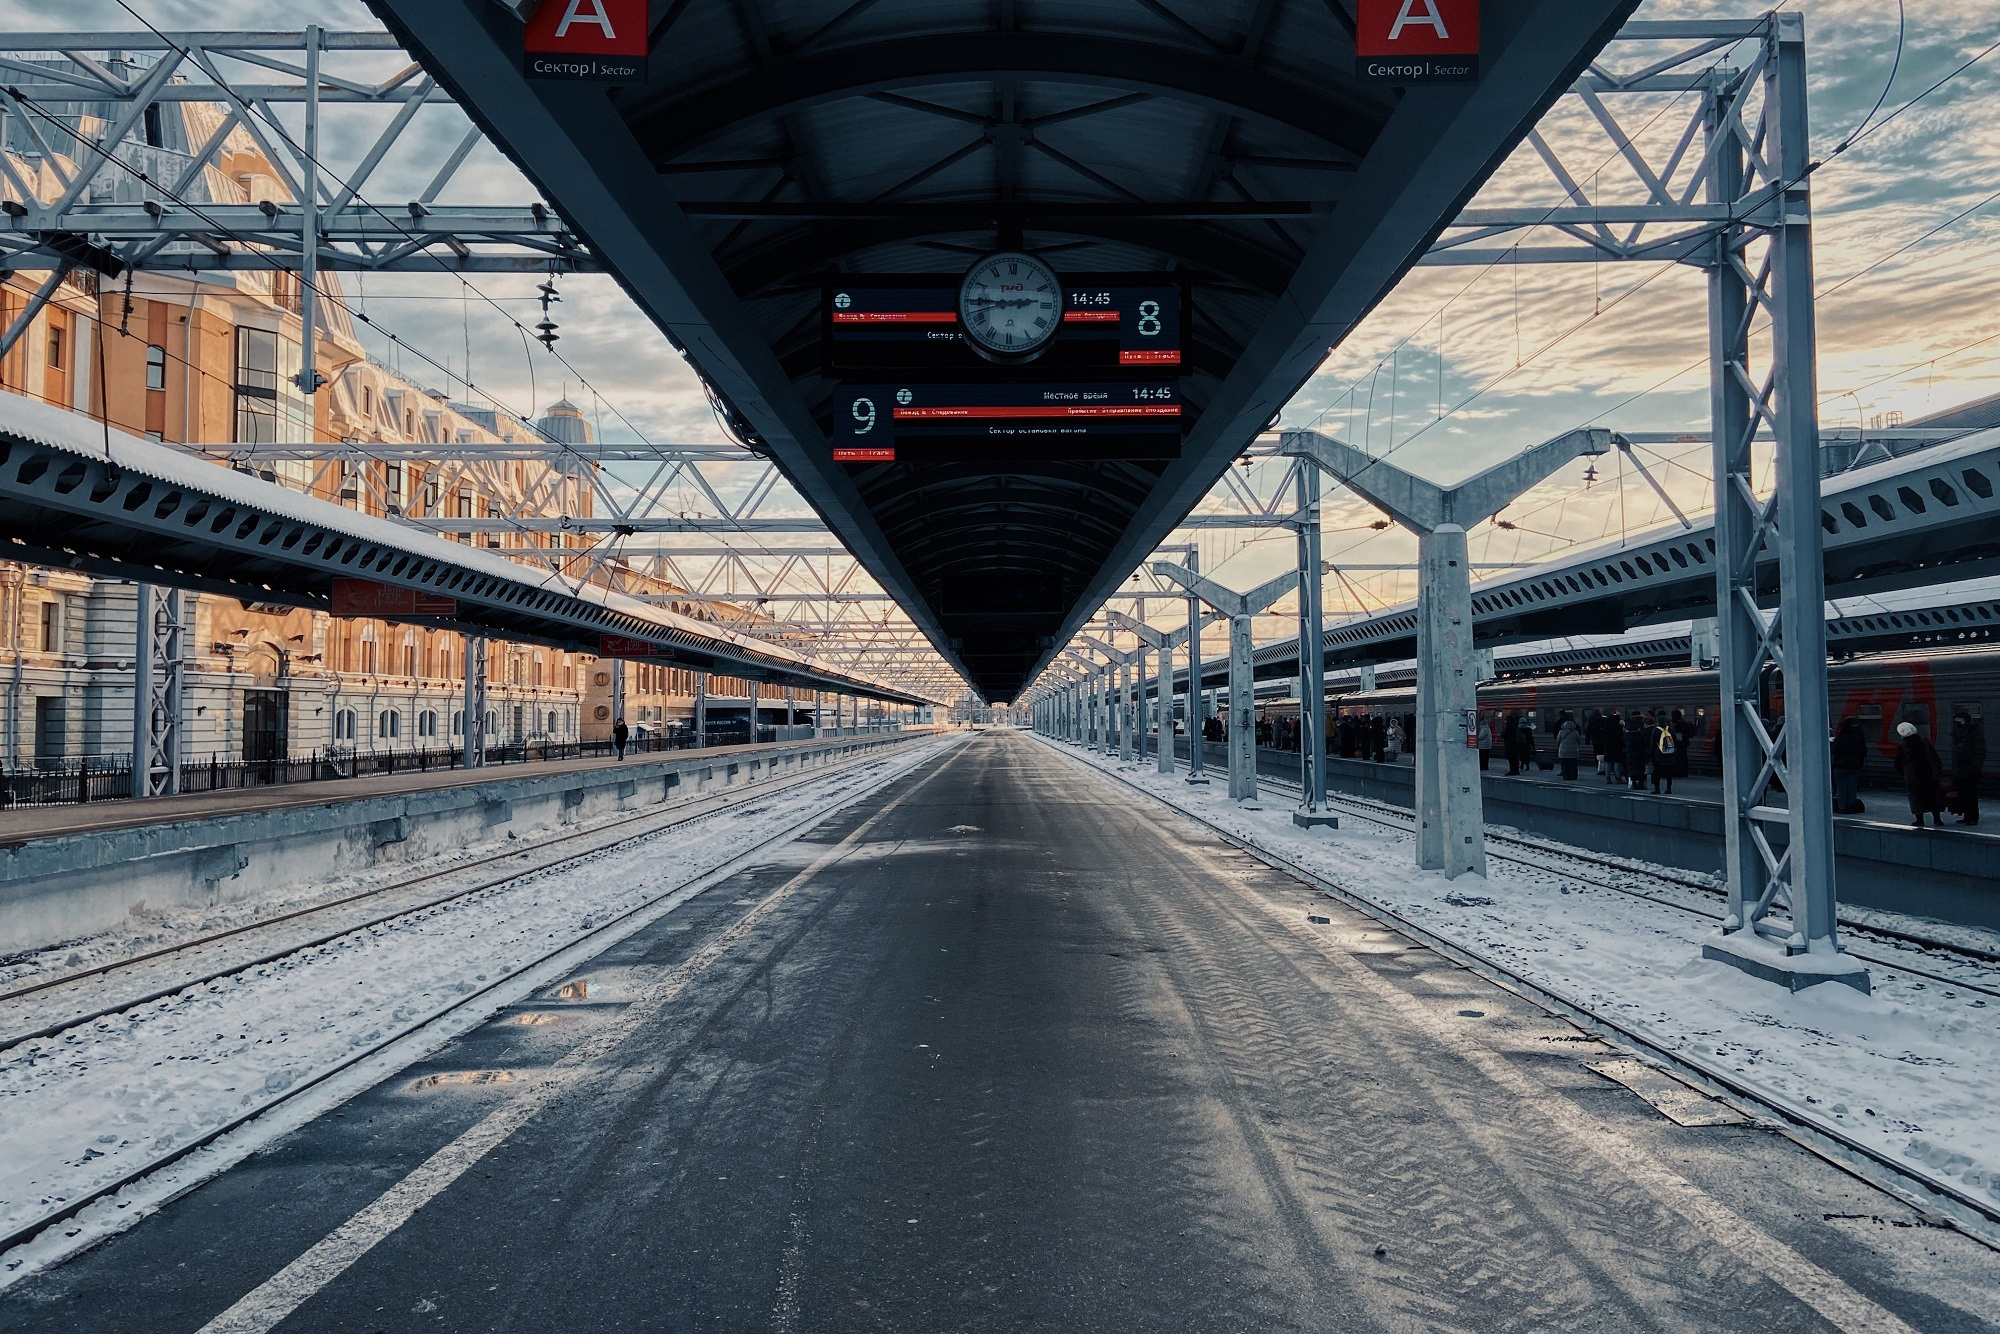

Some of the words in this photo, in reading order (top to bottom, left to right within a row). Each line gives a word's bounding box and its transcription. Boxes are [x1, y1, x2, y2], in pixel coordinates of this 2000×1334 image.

[534, 60, 589, 76] Сектор
[600, 65, 636, 75] Sector
[1367, 63, 1423, 78] Сектор
[1434, 66, 1470, 75] Sector
[1072, 292, 1111, 305] 14:45
[1138, 300, 1161, 336] 8
[927, 331, 954, 340] Сектор
[1043, 391, 1079, 400] Местное
[1083, 391, 1108, 400] время
[1132, 387, 1172, 399] 14:45
[852, 397, 876, 435] 9
